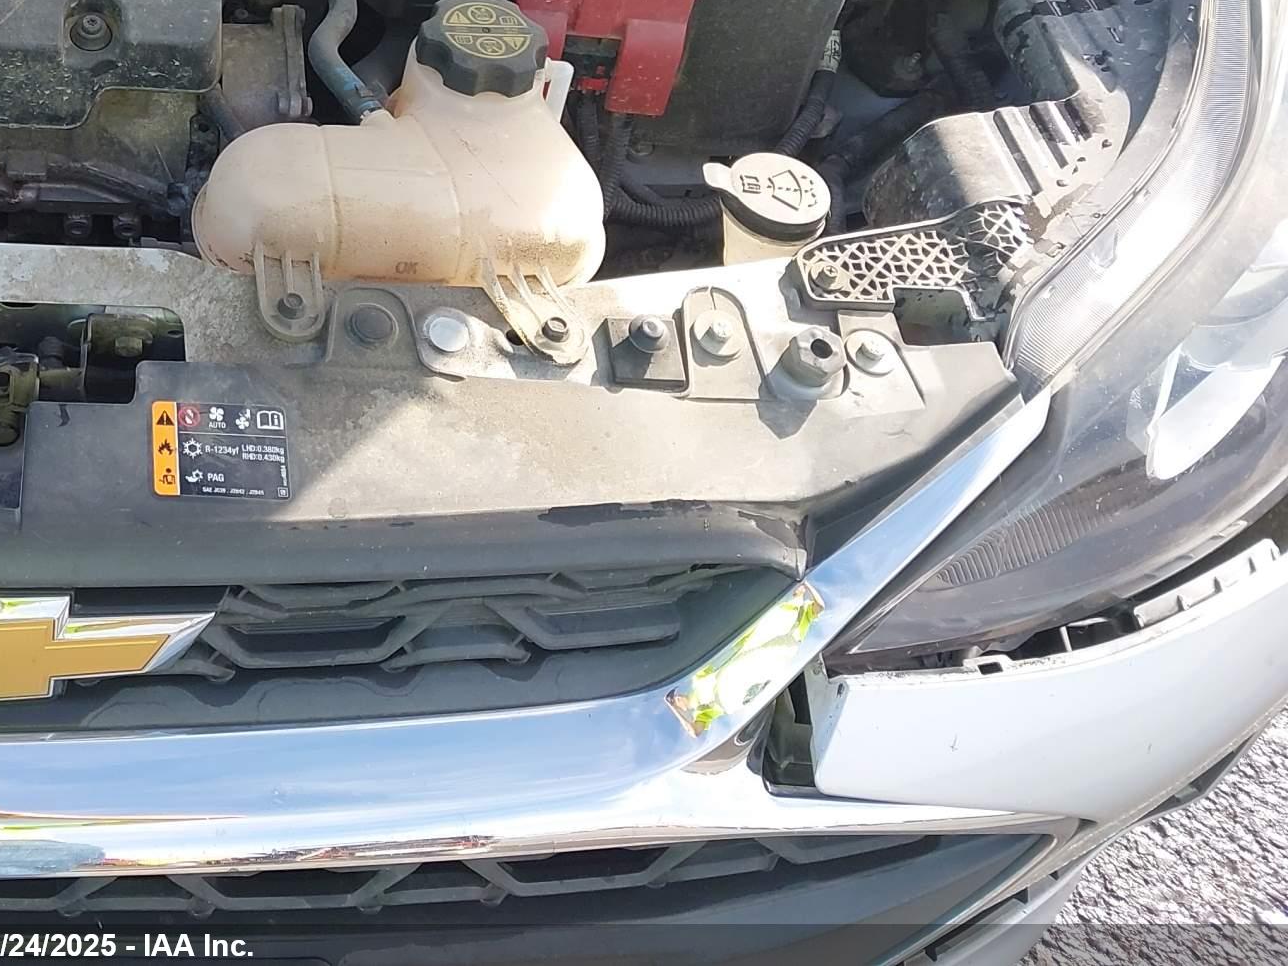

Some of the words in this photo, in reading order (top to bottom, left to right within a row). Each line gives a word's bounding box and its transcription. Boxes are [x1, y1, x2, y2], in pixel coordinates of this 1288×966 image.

[208, 421, 227, 429] AUTO
[205, 444, 239, 455] R-1234yf
[207, 472, 225, 482] PAG
